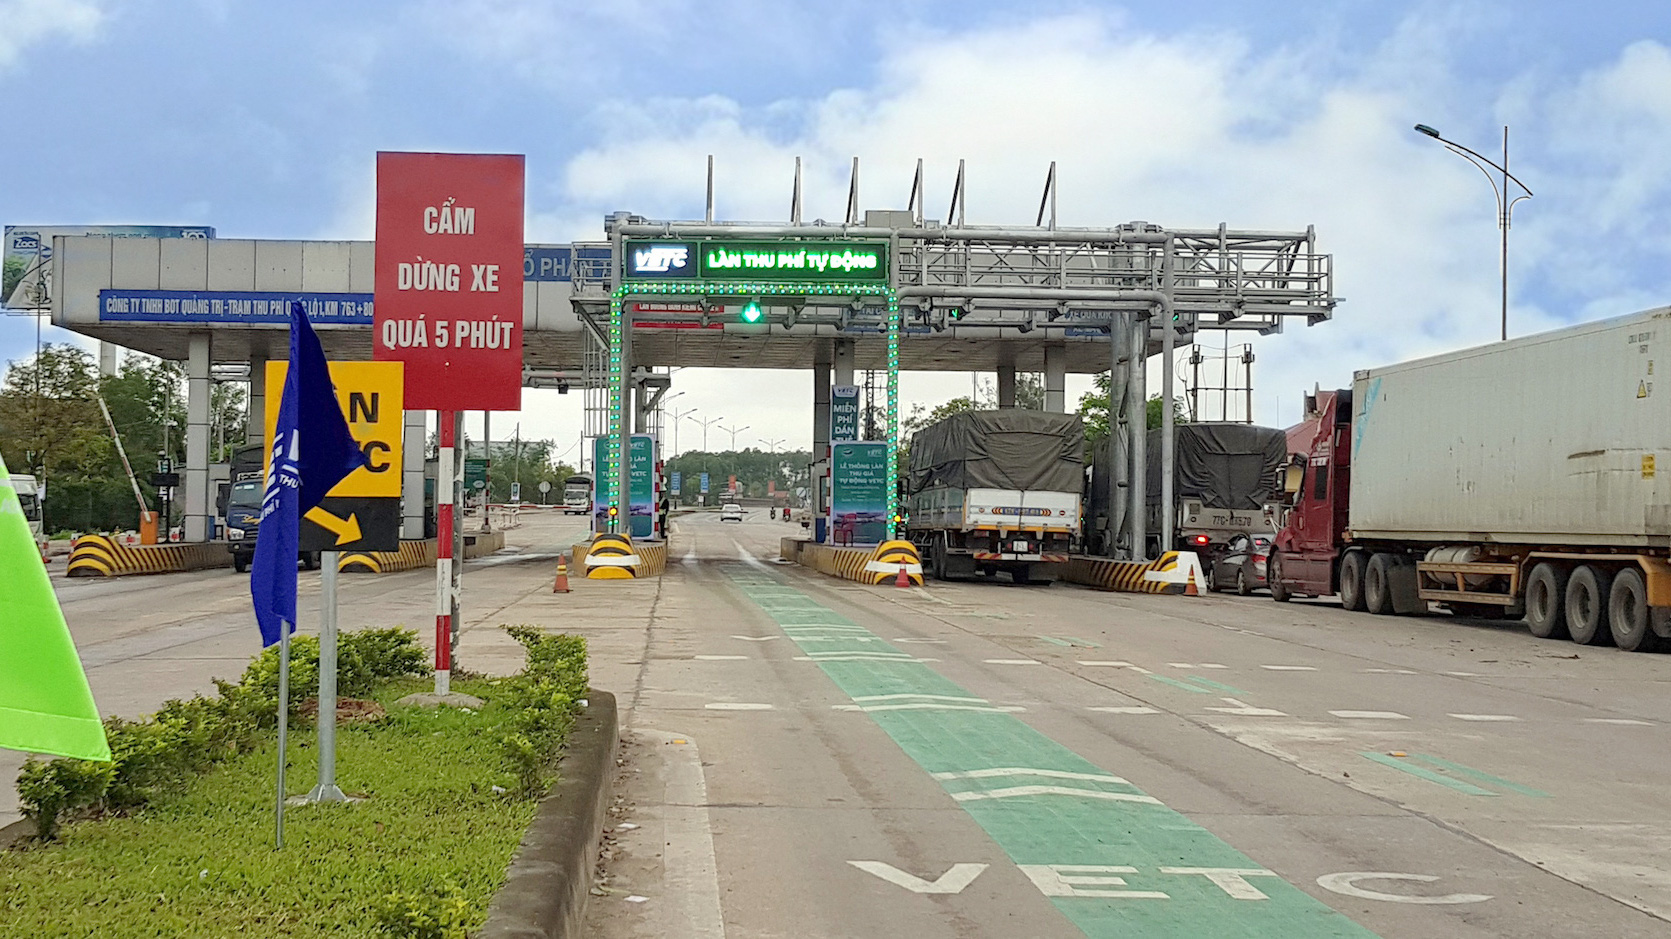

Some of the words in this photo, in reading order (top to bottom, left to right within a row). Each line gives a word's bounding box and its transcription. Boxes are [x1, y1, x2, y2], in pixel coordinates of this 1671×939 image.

[424, 197, 475, 235] CẤM
[15, 239, 37, 248] Zacs
[635, 248, 688, 272] VETC
[708, 249, 741, 268] LÀN
[743, 253, 775, 268] THU
[777, 250, 806, 268] PHÍ
[807, 253, 829, 272] TỰ
[398, 256, 460, 291] DỪNG
[470, 264, 500, 292] XE
[106, 295, 129, 313] CÔNG
[130, 299, 140, 312] TY
[141, 299, 163, 313] TNHH
[164, 299, 180, 314] BOT
[181, 295, 209, 316] QUẢNG
[253, 300, 269, 315] THU
[270, 297, 284, 315] PHÍ
[382, 314, 429, 350] QUÁ
[435, 320, 449, 348] 5
[454, 315, 514, 349] PHÚT
[834, 424, 855, 434] DÁN
[837, 414, 853, 424] PHÍ
[280, 474, 300, 489] THU
[847, 860, 1495, 905] VETC
